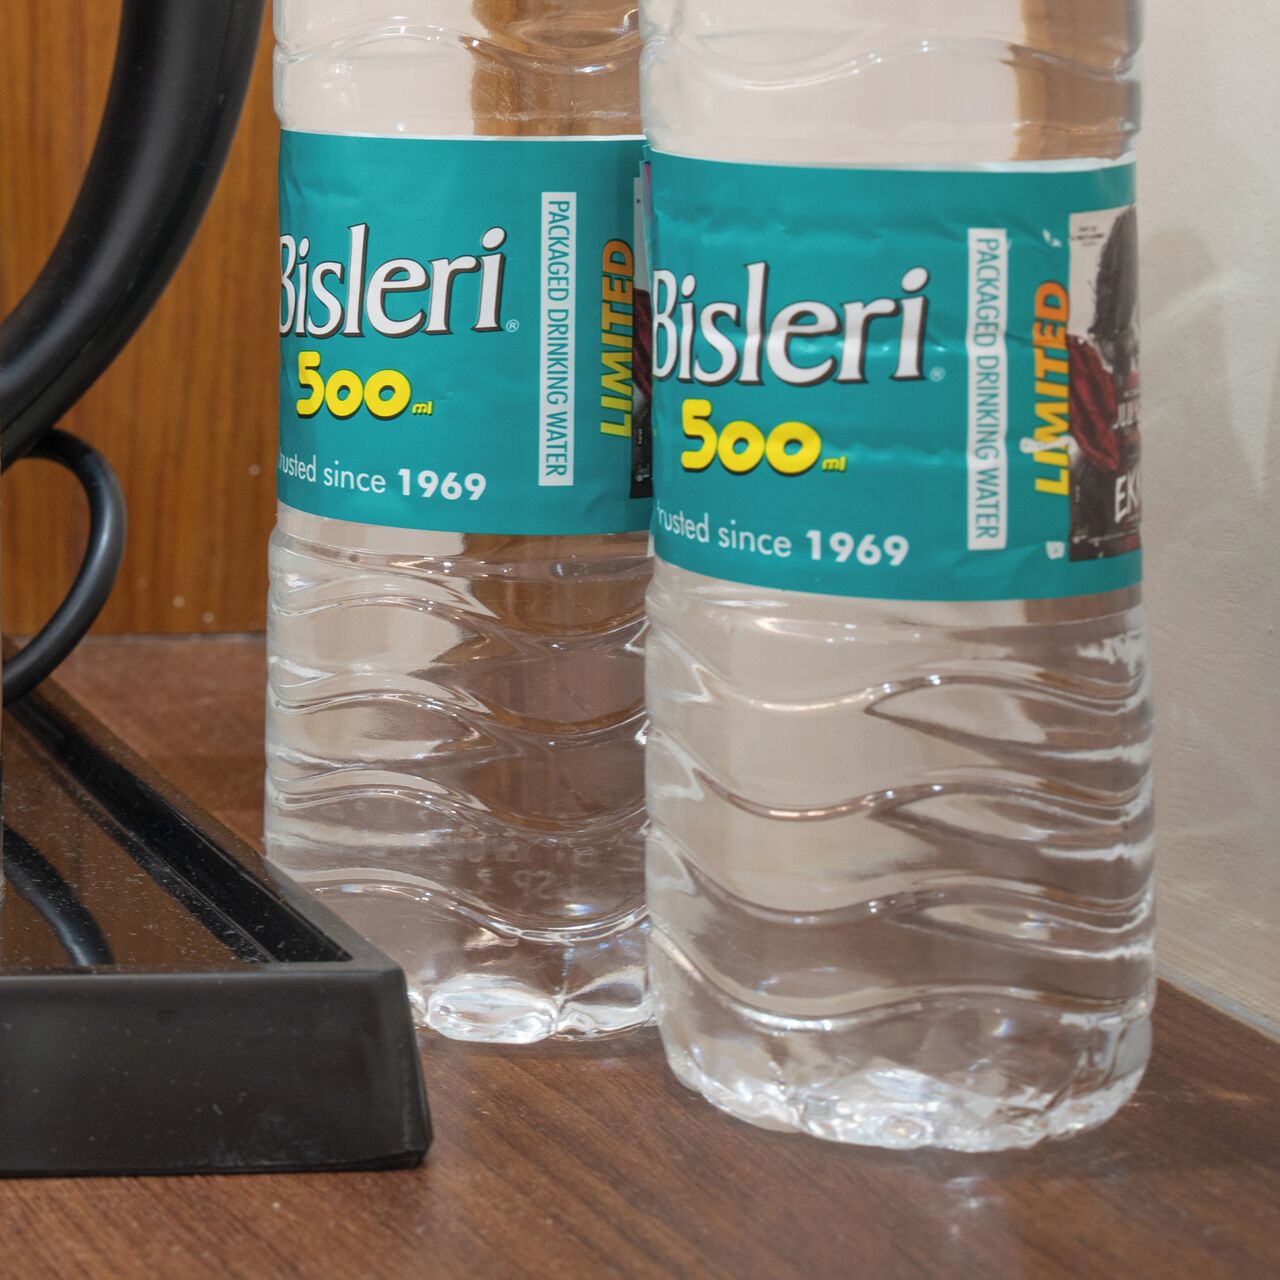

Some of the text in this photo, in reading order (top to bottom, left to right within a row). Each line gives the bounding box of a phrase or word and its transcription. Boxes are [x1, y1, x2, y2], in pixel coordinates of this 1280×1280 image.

[280, 223, 509, 339] Bisleri
[545, 200, 570, 477] PACKAGED DRINKING WATER
[600, 238, 635, 438] LIMITED
[652, 261, 930, 387] Bisleri
[296, 351, 411, 419] 500
[680, 399, 822, 475] 500
[974, 237, 1000, 539] PACKAGED DRINKING WATER
[1032, 280, 1070, 497] LIMITED
[278, 450, 487, 501] rusted since 1969
[717, 519, 792, 558] since
[806, 529, 910, 567] 1969
